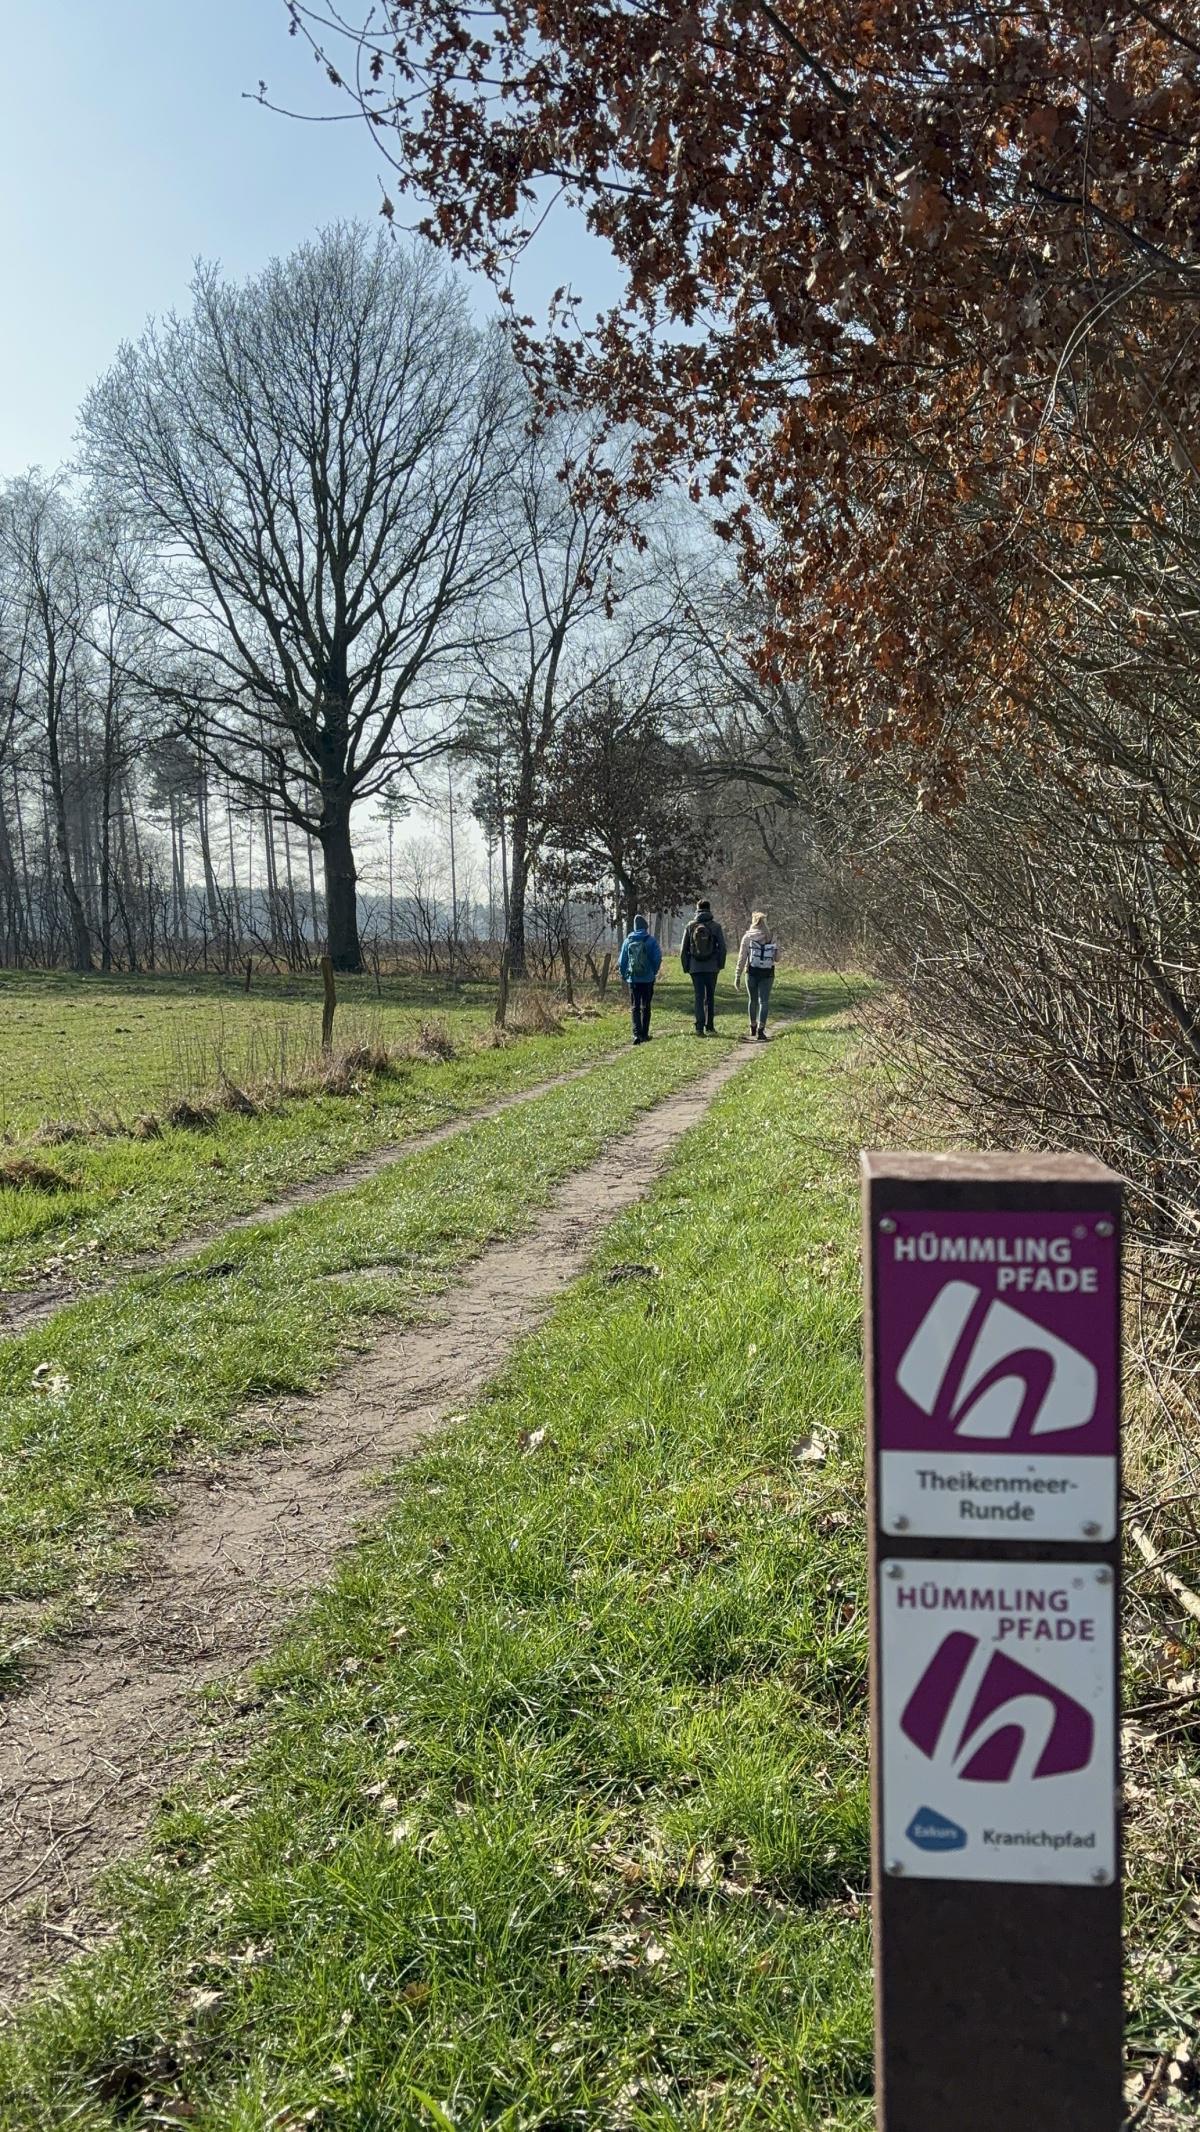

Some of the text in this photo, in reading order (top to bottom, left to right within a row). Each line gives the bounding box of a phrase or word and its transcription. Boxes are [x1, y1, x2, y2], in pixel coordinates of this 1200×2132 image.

[894, 1232, 1071, 1263] HÜMMLING
[997, 1268, 1098, 1292] PFADE
[916, 1470, 1079, 1494] Theikenmeer-
[960, 1500, 1035, 1521] Runde
[897, 1582, 1069, 1612] HÜMMLING
[998, 1618, 1095, 1642] PFADE
[983, 1829, 1096, 1850] Kranichpfad
